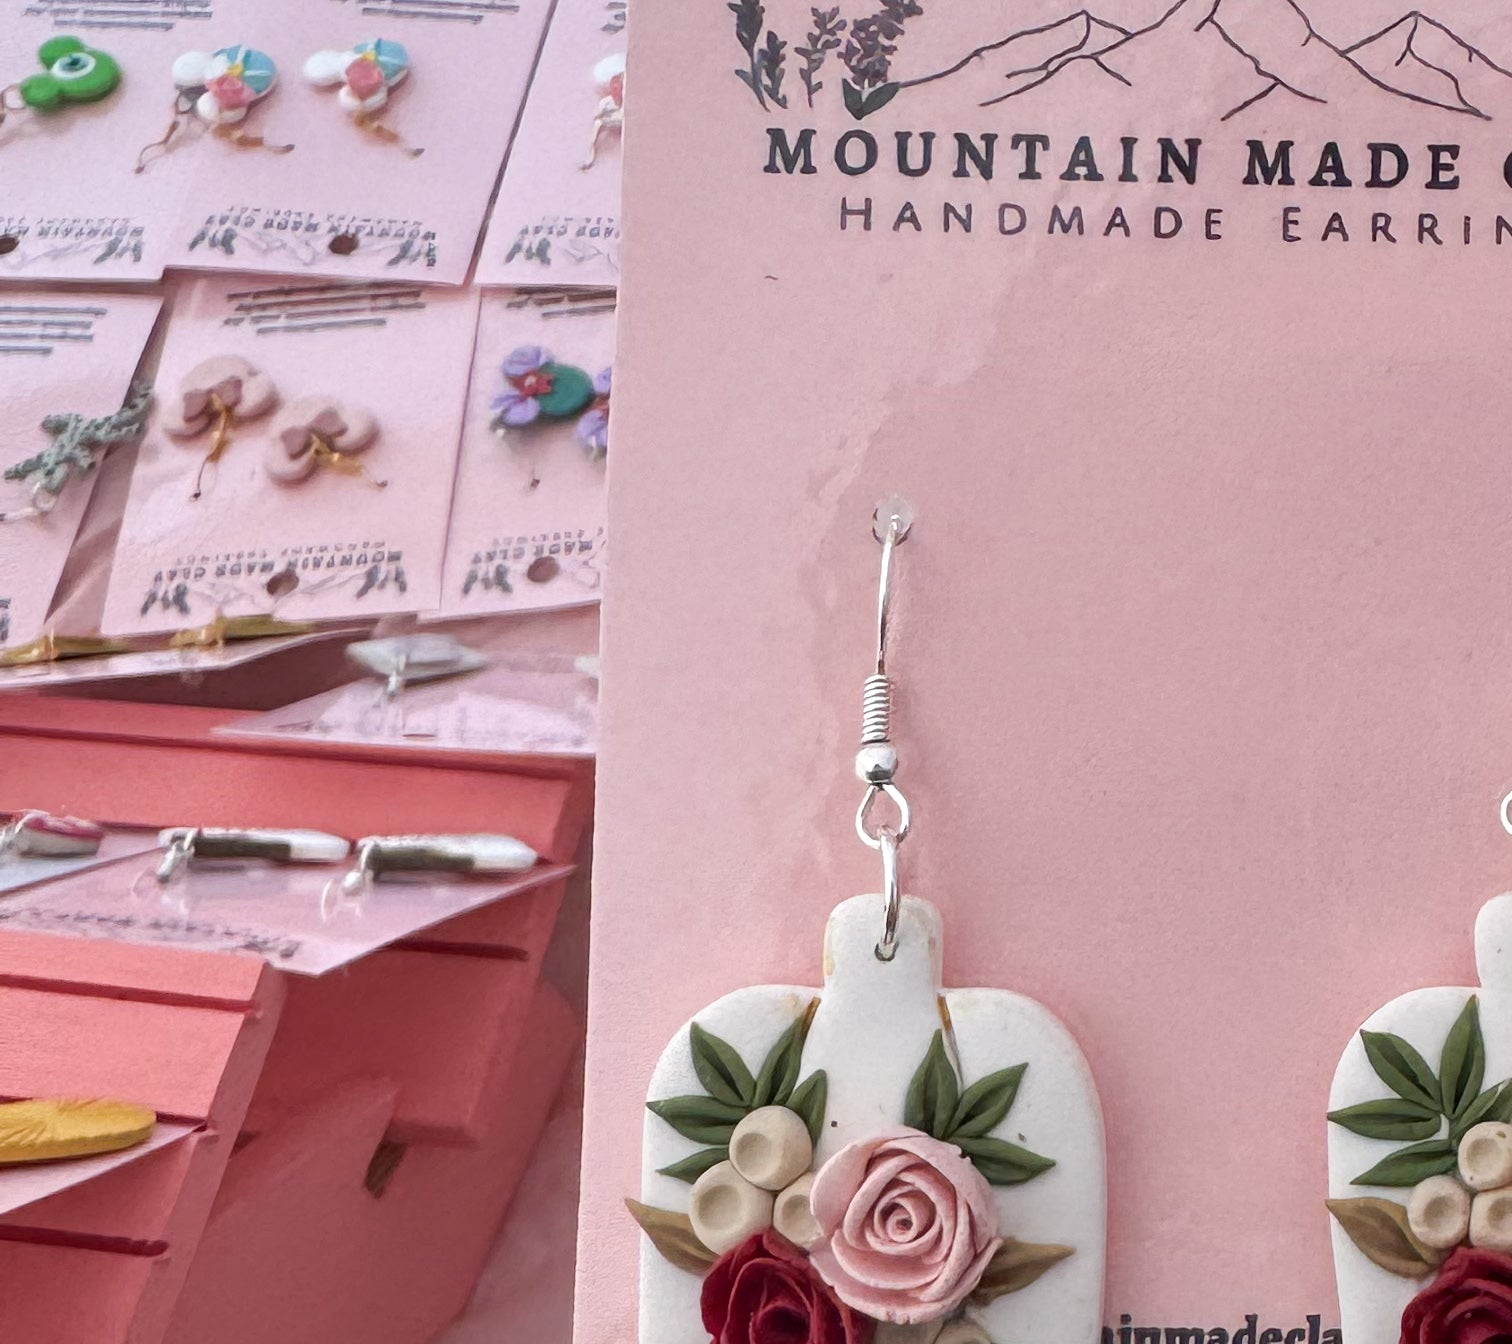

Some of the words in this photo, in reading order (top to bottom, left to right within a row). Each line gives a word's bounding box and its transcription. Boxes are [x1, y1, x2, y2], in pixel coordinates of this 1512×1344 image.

[763, 127, 1203, 186] MOUNTAIN
[1241, 139, 1462, 190] MADE
[840, 196, 1225, 241] HANDMADE
